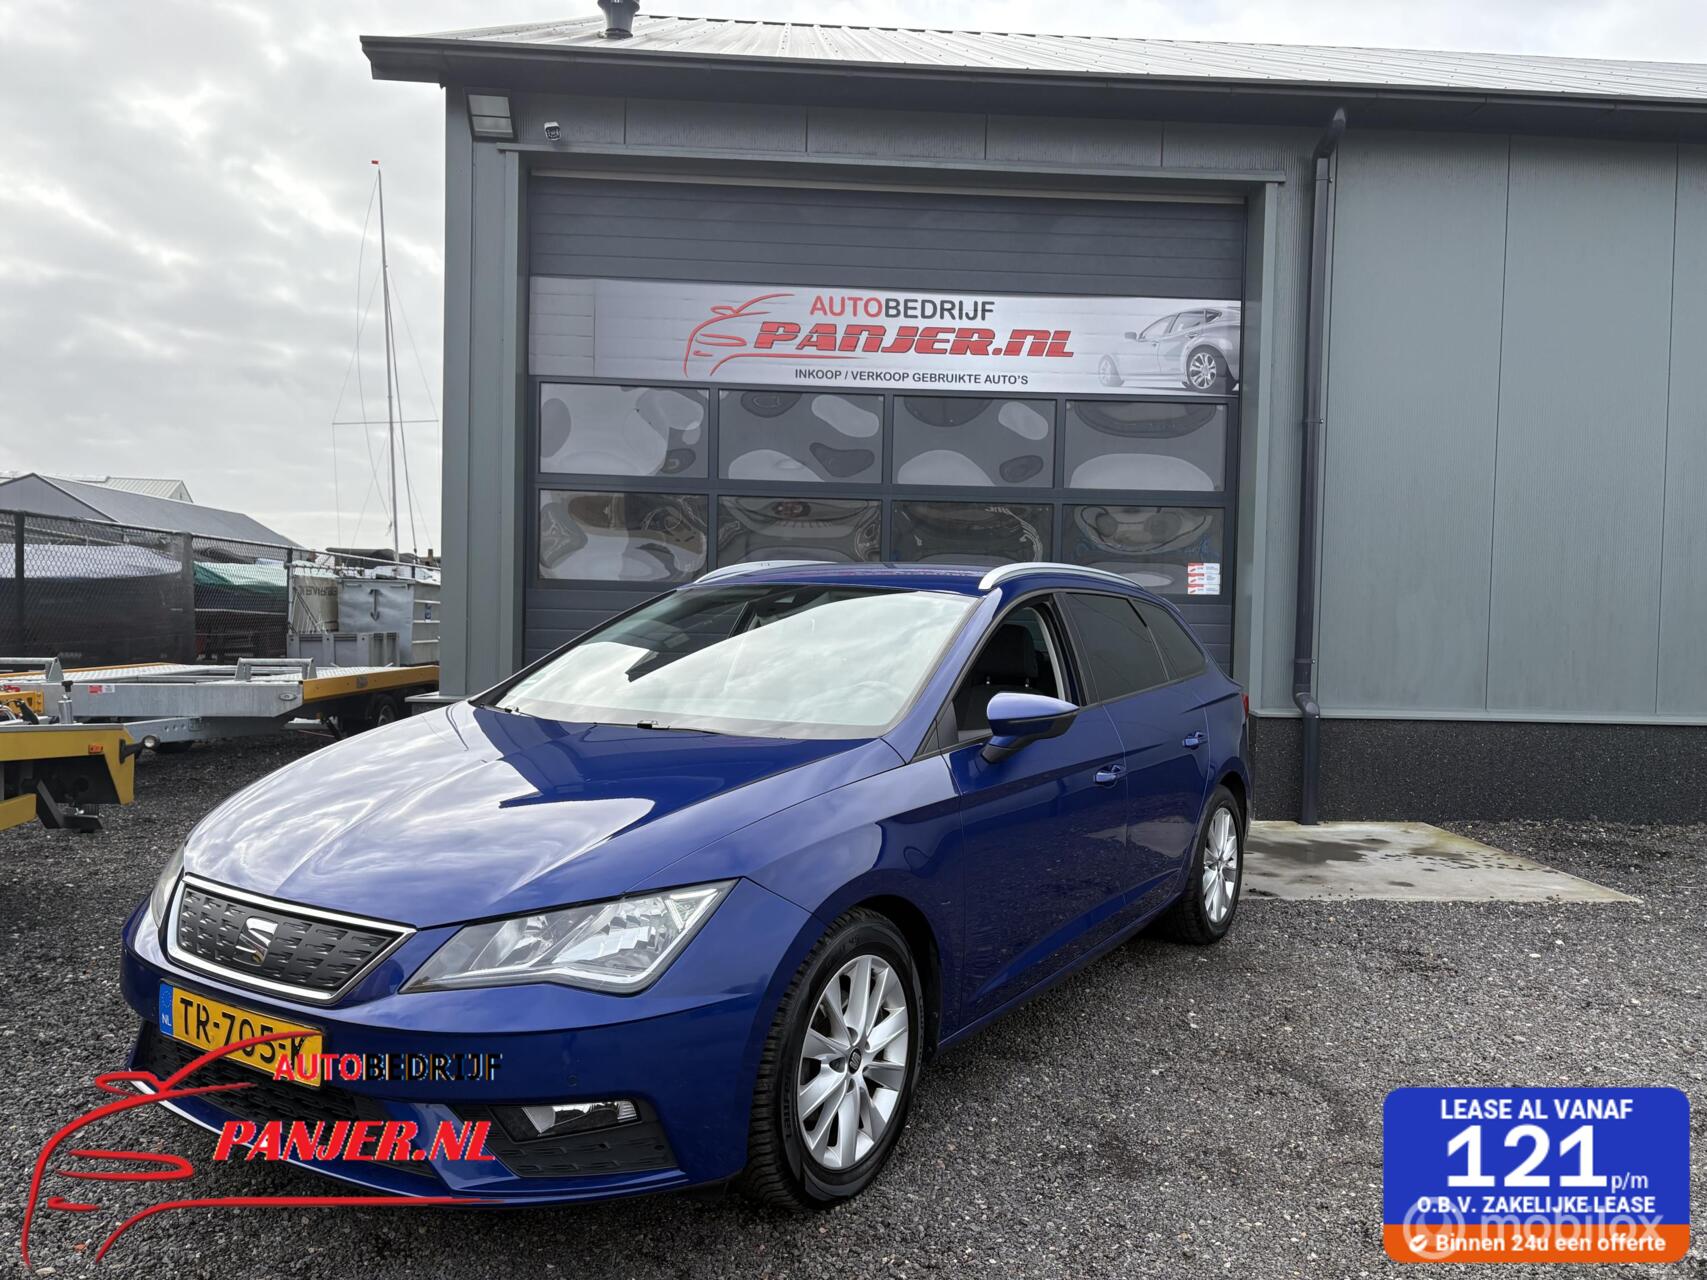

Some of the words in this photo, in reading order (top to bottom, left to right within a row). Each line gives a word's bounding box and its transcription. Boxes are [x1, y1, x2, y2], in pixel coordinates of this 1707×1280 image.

[810, 296, 995, 321] AUTOBEDRIJF
[795, 369, 842, 380] INKOOP
[852, 370, 909, 382] VERKOOP
[912, 372, 981, 384] GEBRUIKTE
[984, 374, 1029, 385] AUTO'S
[161, 1014, 172, 1027] NL
